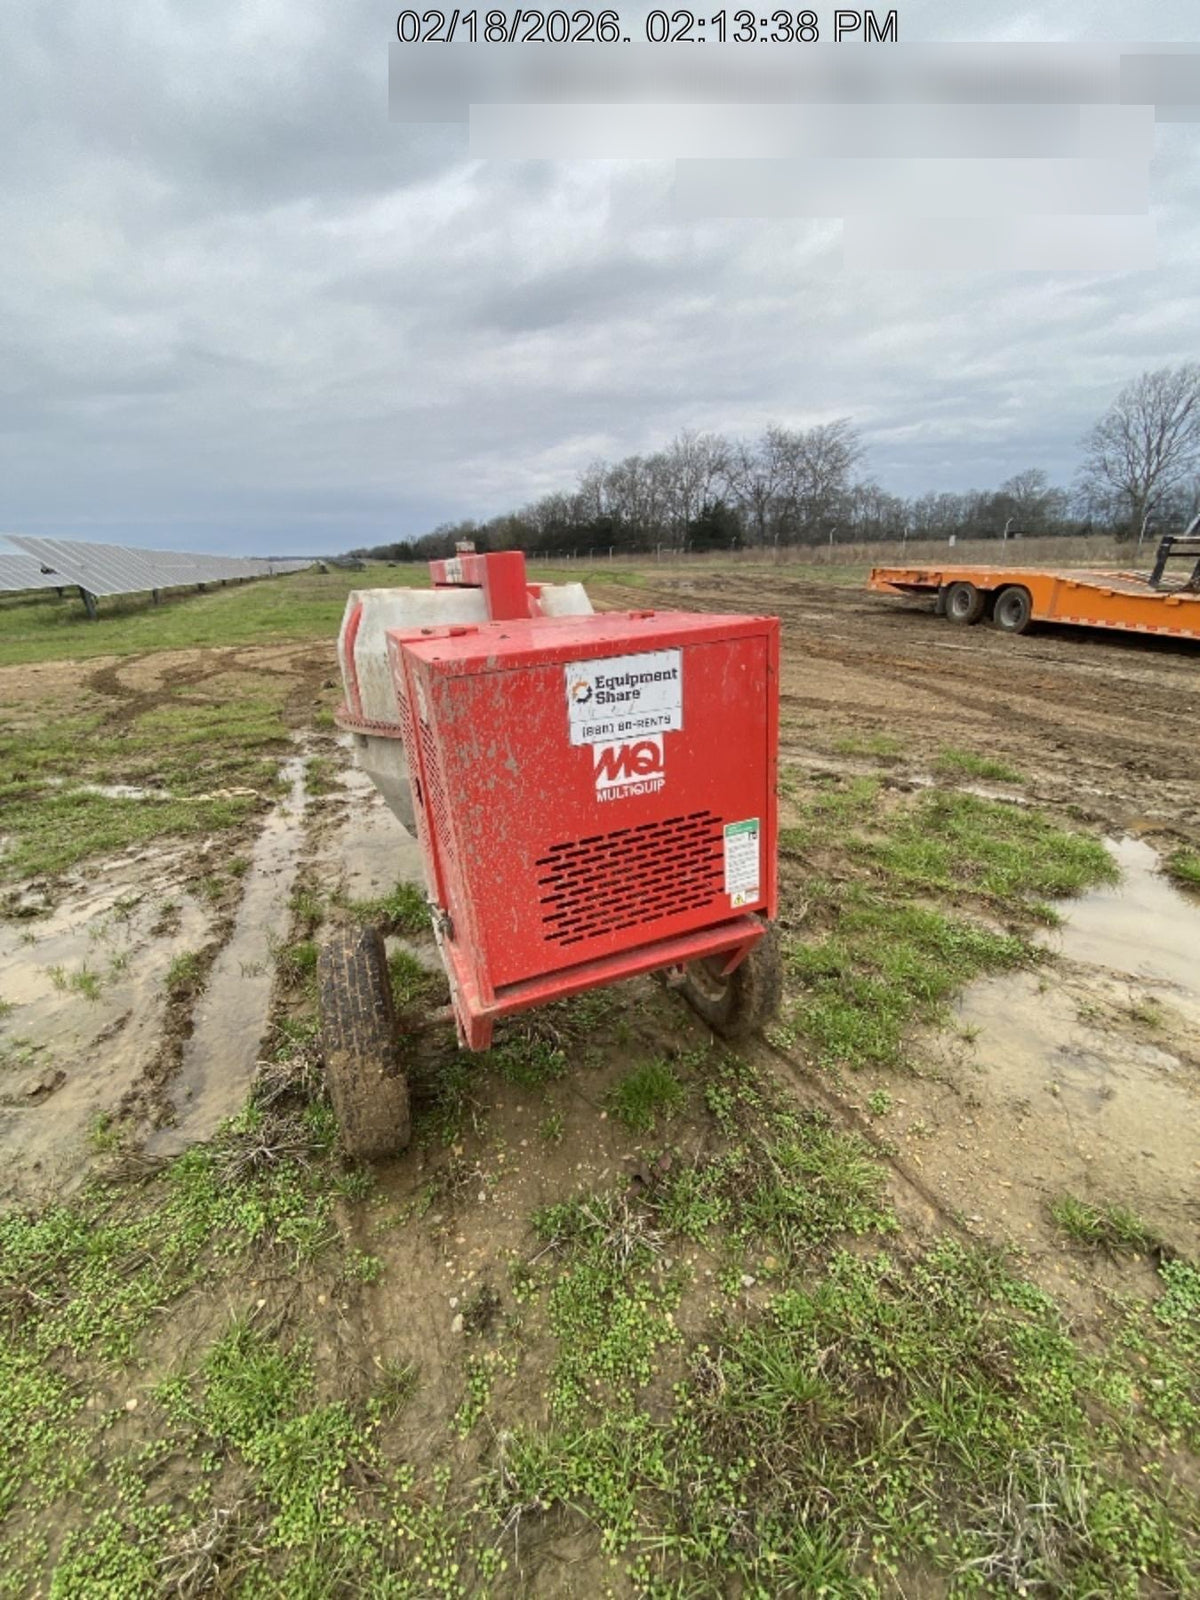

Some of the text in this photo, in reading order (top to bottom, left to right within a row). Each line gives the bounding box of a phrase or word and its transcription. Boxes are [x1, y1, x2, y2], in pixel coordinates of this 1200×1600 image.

[594, 668, 679, 690] Equipment
[595, 689, 641, 705] Share
[594, 740, 664, 782] MQ
[596, 778, 666, 803] MULTIQUIP
